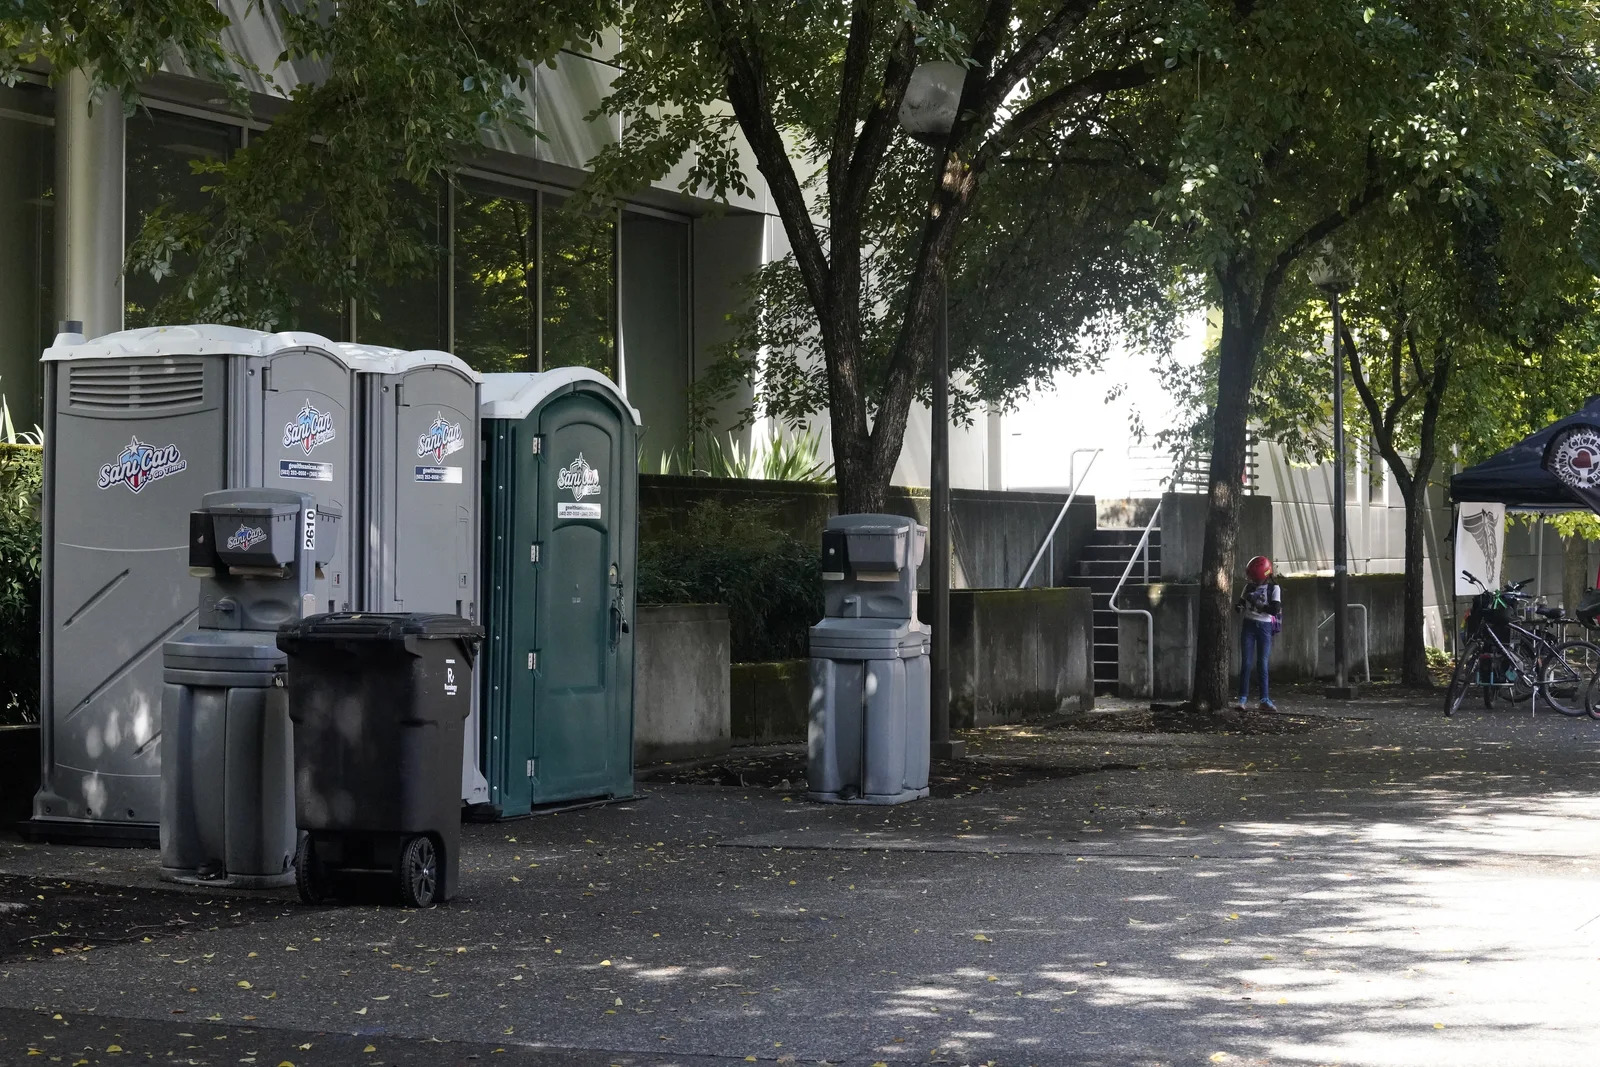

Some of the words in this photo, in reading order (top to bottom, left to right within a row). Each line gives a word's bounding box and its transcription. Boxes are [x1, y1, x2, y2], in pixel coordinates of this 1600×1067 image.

[284, 420, 311, 446] Sani
[311, 411, 333, 436] Can
[417, 433, 442, 455] Sani
[442, 423, 462, 445] Can
[98, 459, 141, 488] Sani
[140, 444, 180, 471] Can
[153, 469, 164, 479] Go
[164, 460, 186, 475] Time!
[557, 470, 582, 488] Sani
[227, 536, 247, 548] Sani
[246, 529, 262, 541] Can
[305, 510, 315, 548] 2610
